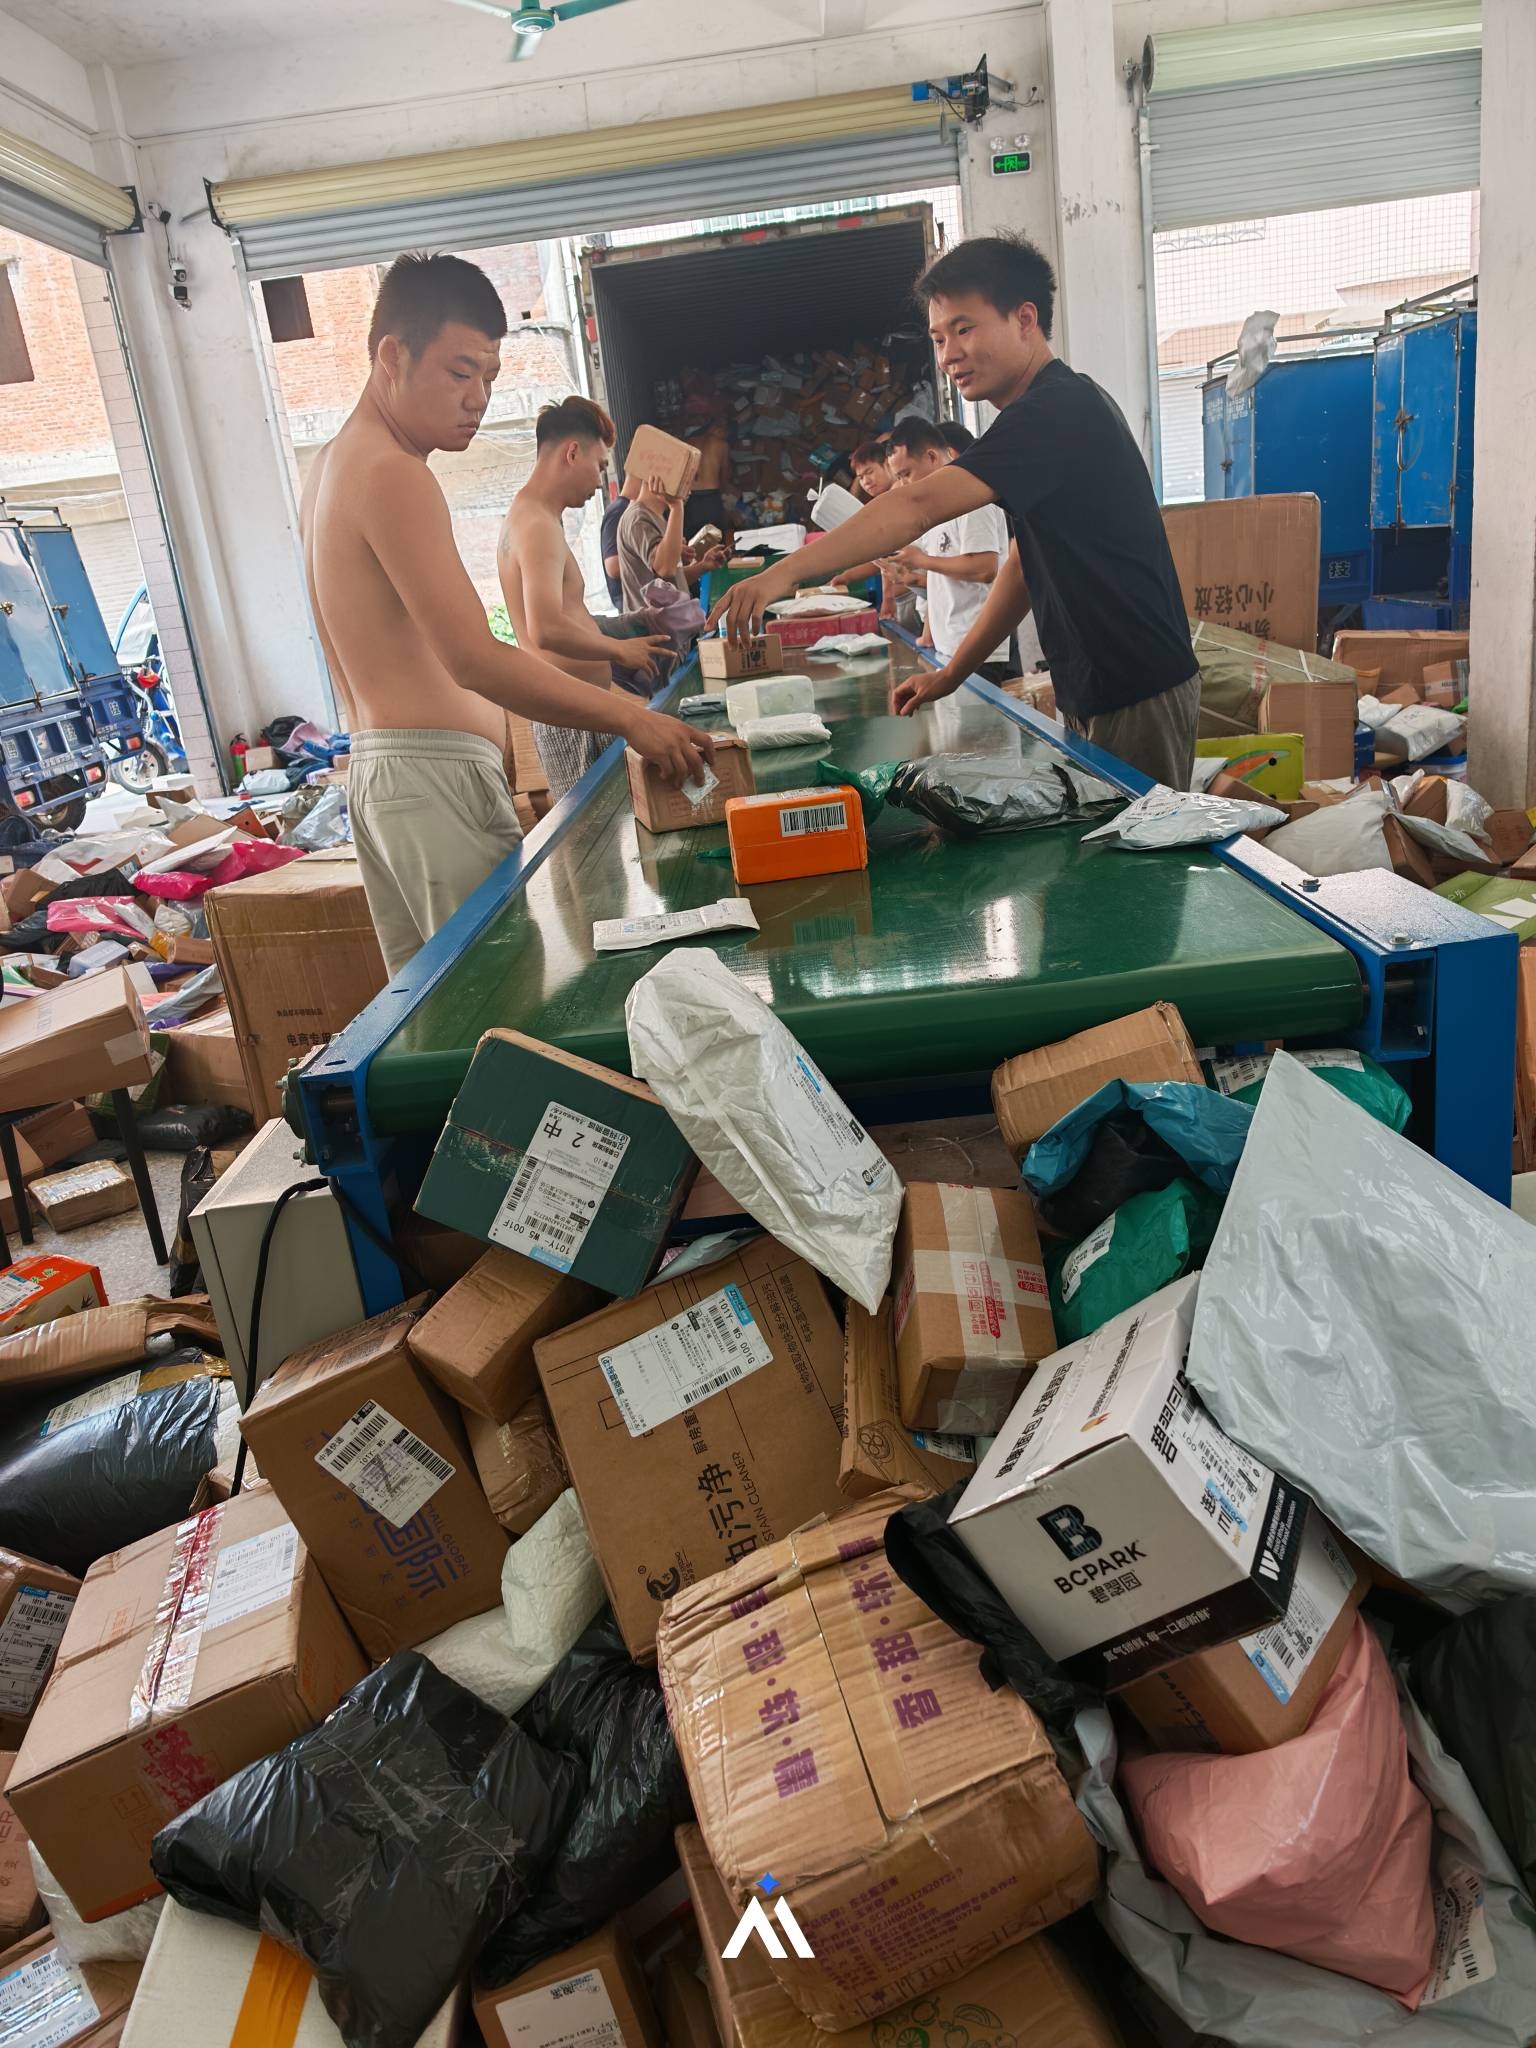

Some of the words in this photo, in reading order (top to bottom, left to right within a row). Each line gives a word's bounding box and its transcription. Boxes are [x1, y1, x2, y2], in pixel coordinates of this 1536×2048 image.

[1194, 582, 1274, 614] 小心轻放
[541, 1116, 565, 1141] 中
[569, 1130, 585, 1149] 2
[503, 1218, 525, 1233] 001F
[717, 1298, 734, 1324] 101Y-
[731, 1326, 743, 1340] W5
[739, 1341, 755, 1364] 001G
[760, 1280, 816, 1394] 植物提取物快速分解油污
[318, 1435, 344, 1461] 中通快递
[730, 1450, 760, 1505] CLEANER
[752, 1506, 774, 1542] STAIN
[1053, 1540, 1147, 1594] BCPARK
[1087, 1569, 1142, 1605] 碧翠园
